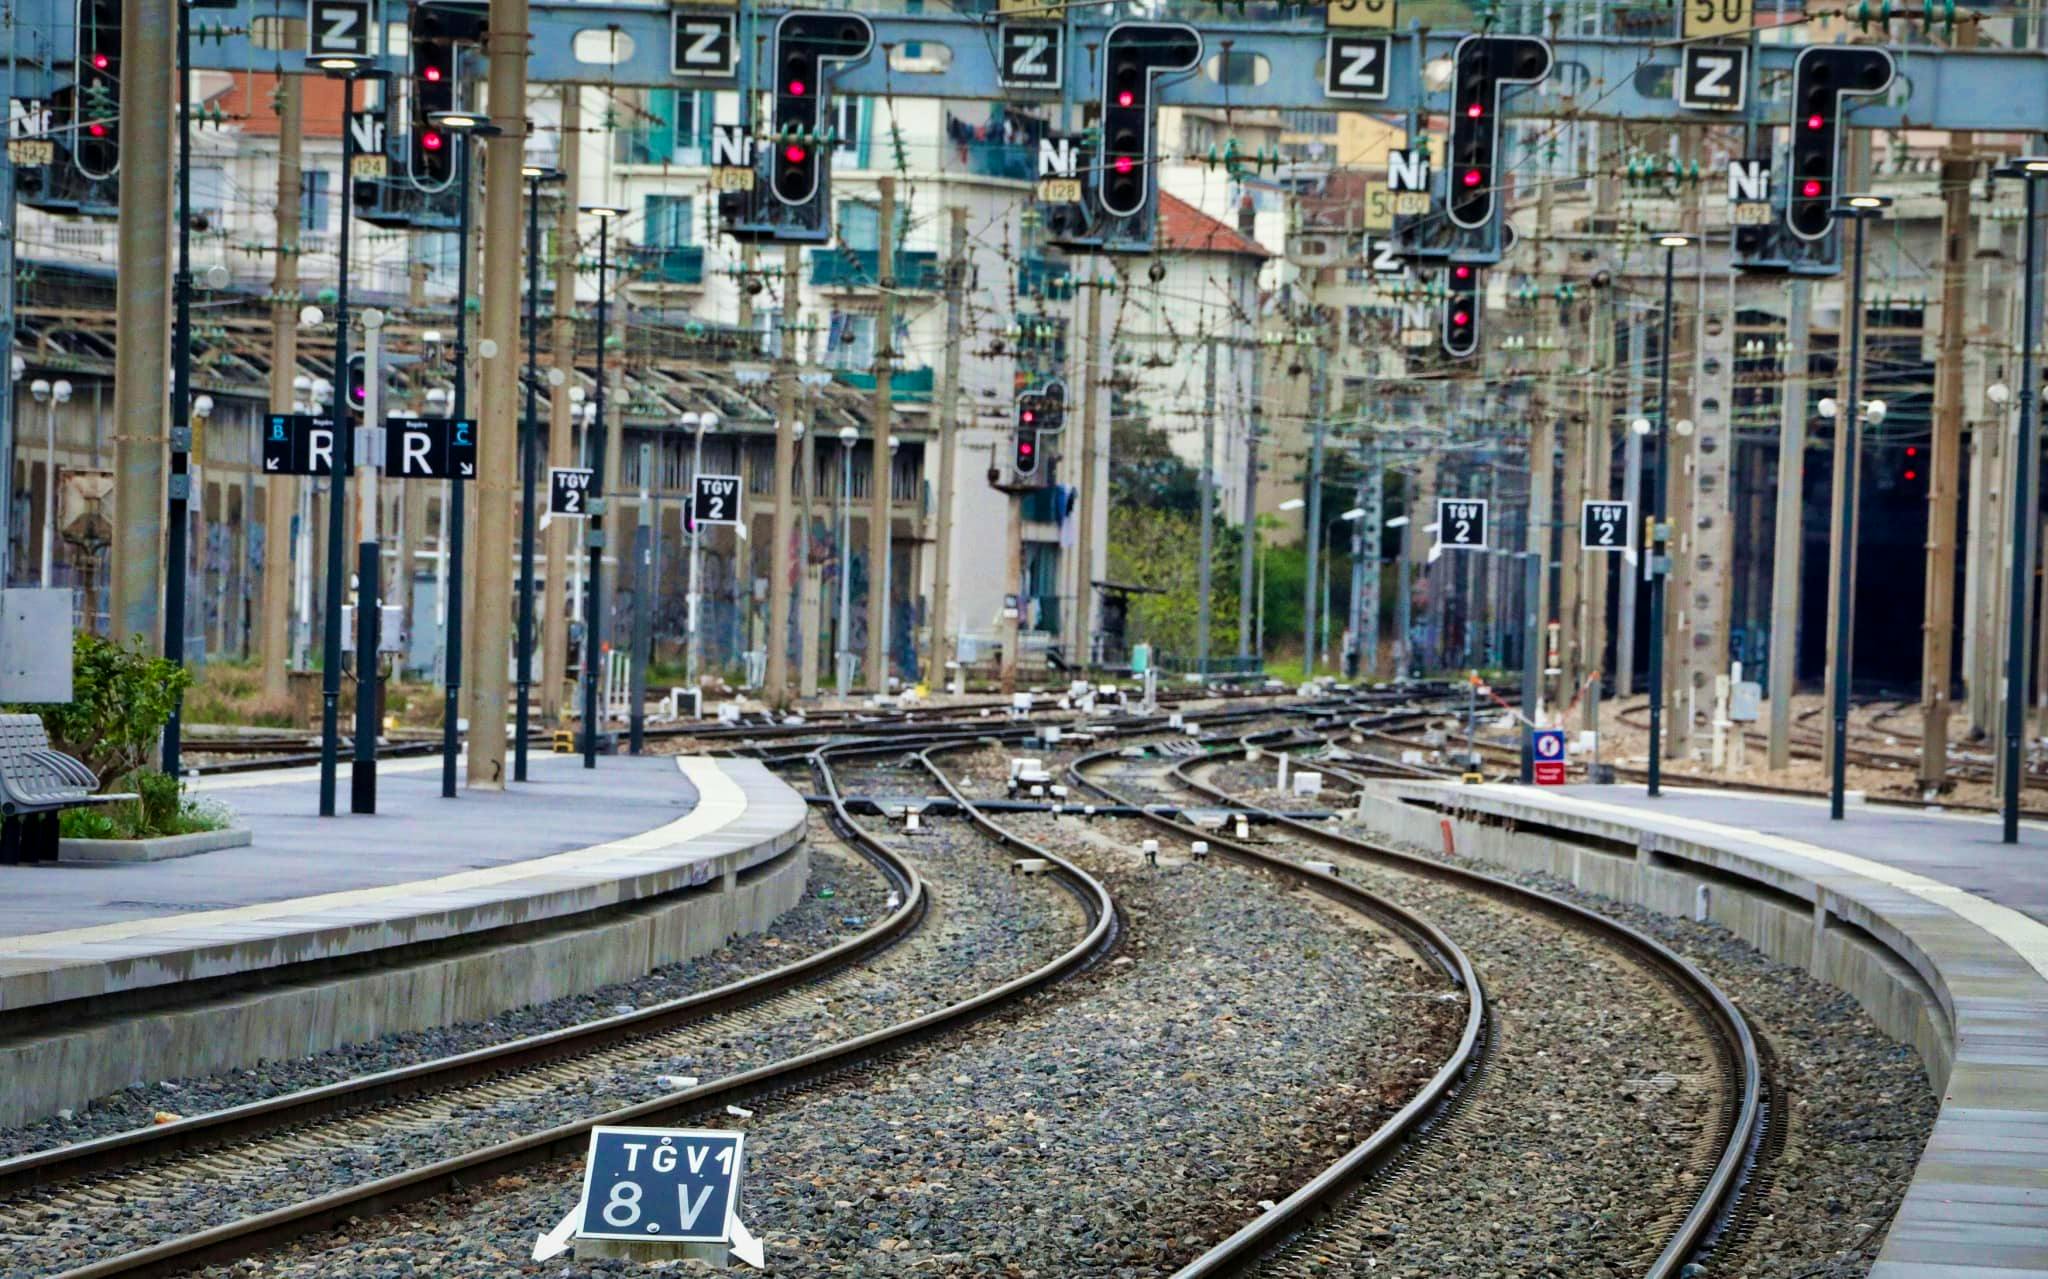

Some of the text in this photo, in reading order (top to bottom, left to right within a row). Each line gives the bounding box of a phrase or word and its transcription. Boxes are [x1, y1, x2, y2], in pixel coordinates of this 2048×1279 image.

[322, 9, 358, 49] Z
[685, 24, 721, 63] Z
[1012, 35, 1049, 75] Z
[1339, 46, 1377, 86] Z
[1695, 56, 1732, 97] Z
[1373, 241, 1401, 270] Z
[273, 424, 284, 439] B
[457, 429, 469, 444] C
[309, 429, 334, 471] R
[403, 431, 433, 474] R
[557, 473, 590, 489] TGV
[701, 480, 734, 496] TGV
[565, 489, 580, 512] 2
[709, 496, 724, 519] 2
[1448, 504, 1478, 520] TGV
[1592, 506, 1622, 522] TGV
[1455, 519, 1470, 542] 2
[1599, 522, 1614, 544] 2
[602, 1180, 715, 1230] 8 V
